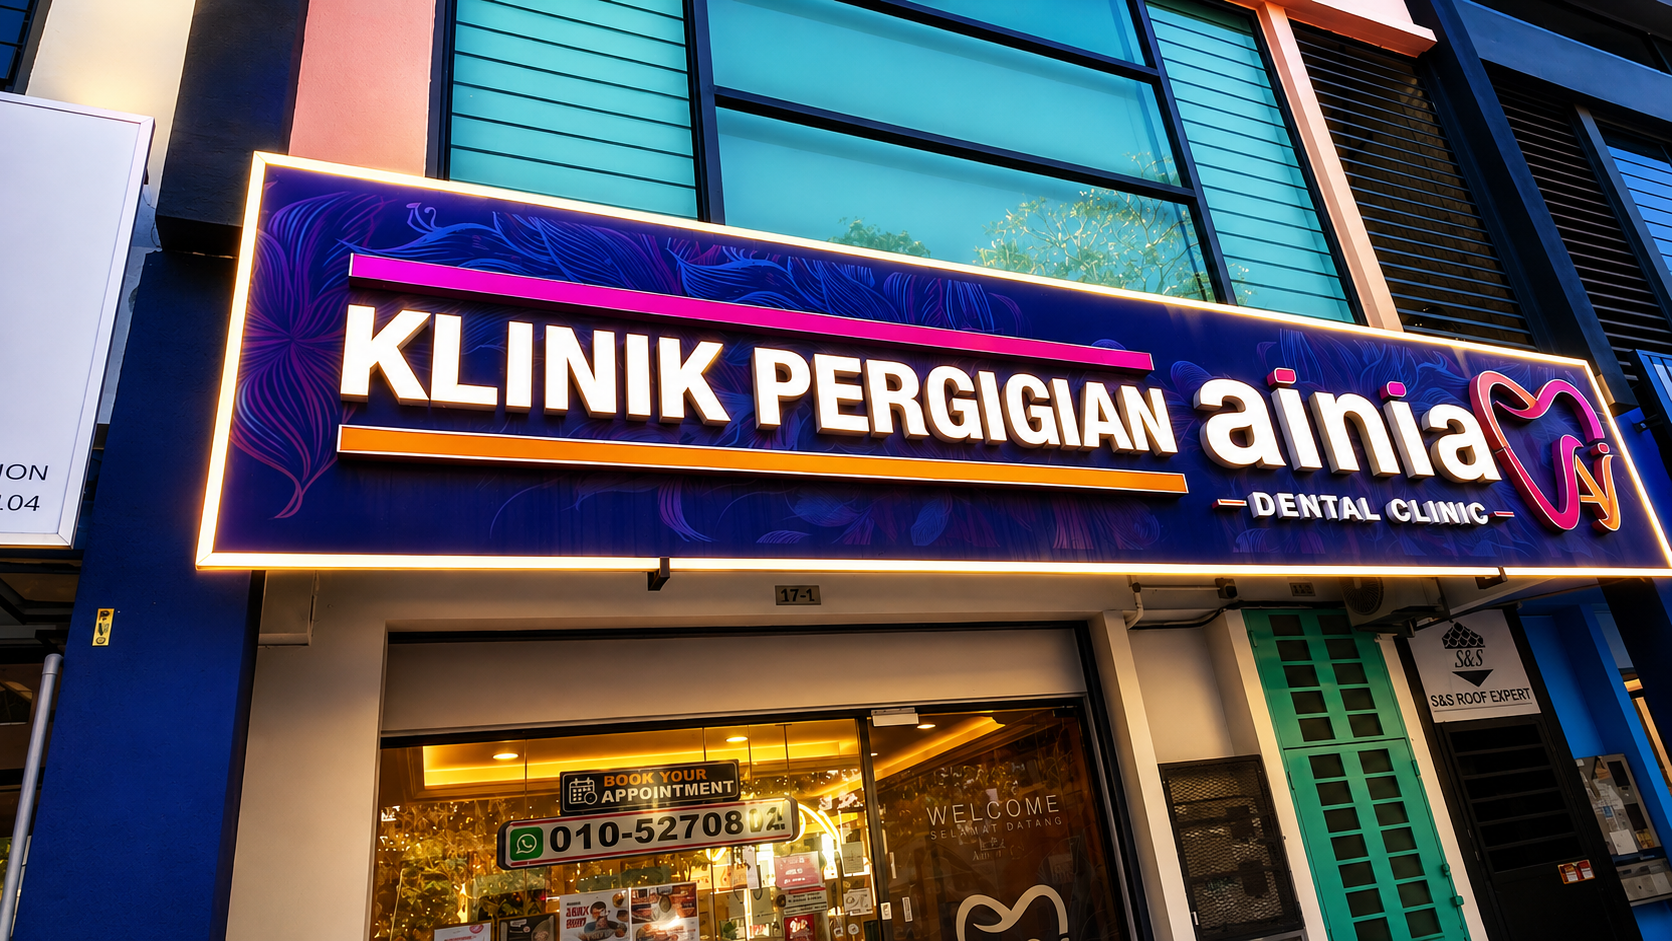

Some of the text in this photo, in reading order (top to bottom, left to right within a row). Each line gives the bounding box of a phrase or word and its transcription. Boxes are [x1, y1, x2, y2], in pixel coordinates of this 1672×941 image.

[340, 304, 1178, 458] KLINIK PERGIGIAN
[1194, 367, 1502, 483] ainia
[1247, 491, 1489, 526] DENTAL CLINIC
[780, 588, 815, 602] 17-1
[1455, 649, 1483, 668] S&S
[1430, 687, 1531, 707] S&S ROOF EXPERT
[603, 768, 707, 788] BOOK YOUR
[601, 780, 734, 804] APPOINTMENT
[926, 795, 1059, 826] WELCOME
[930, 816, 1062, 840] SELAMAT DATANG
